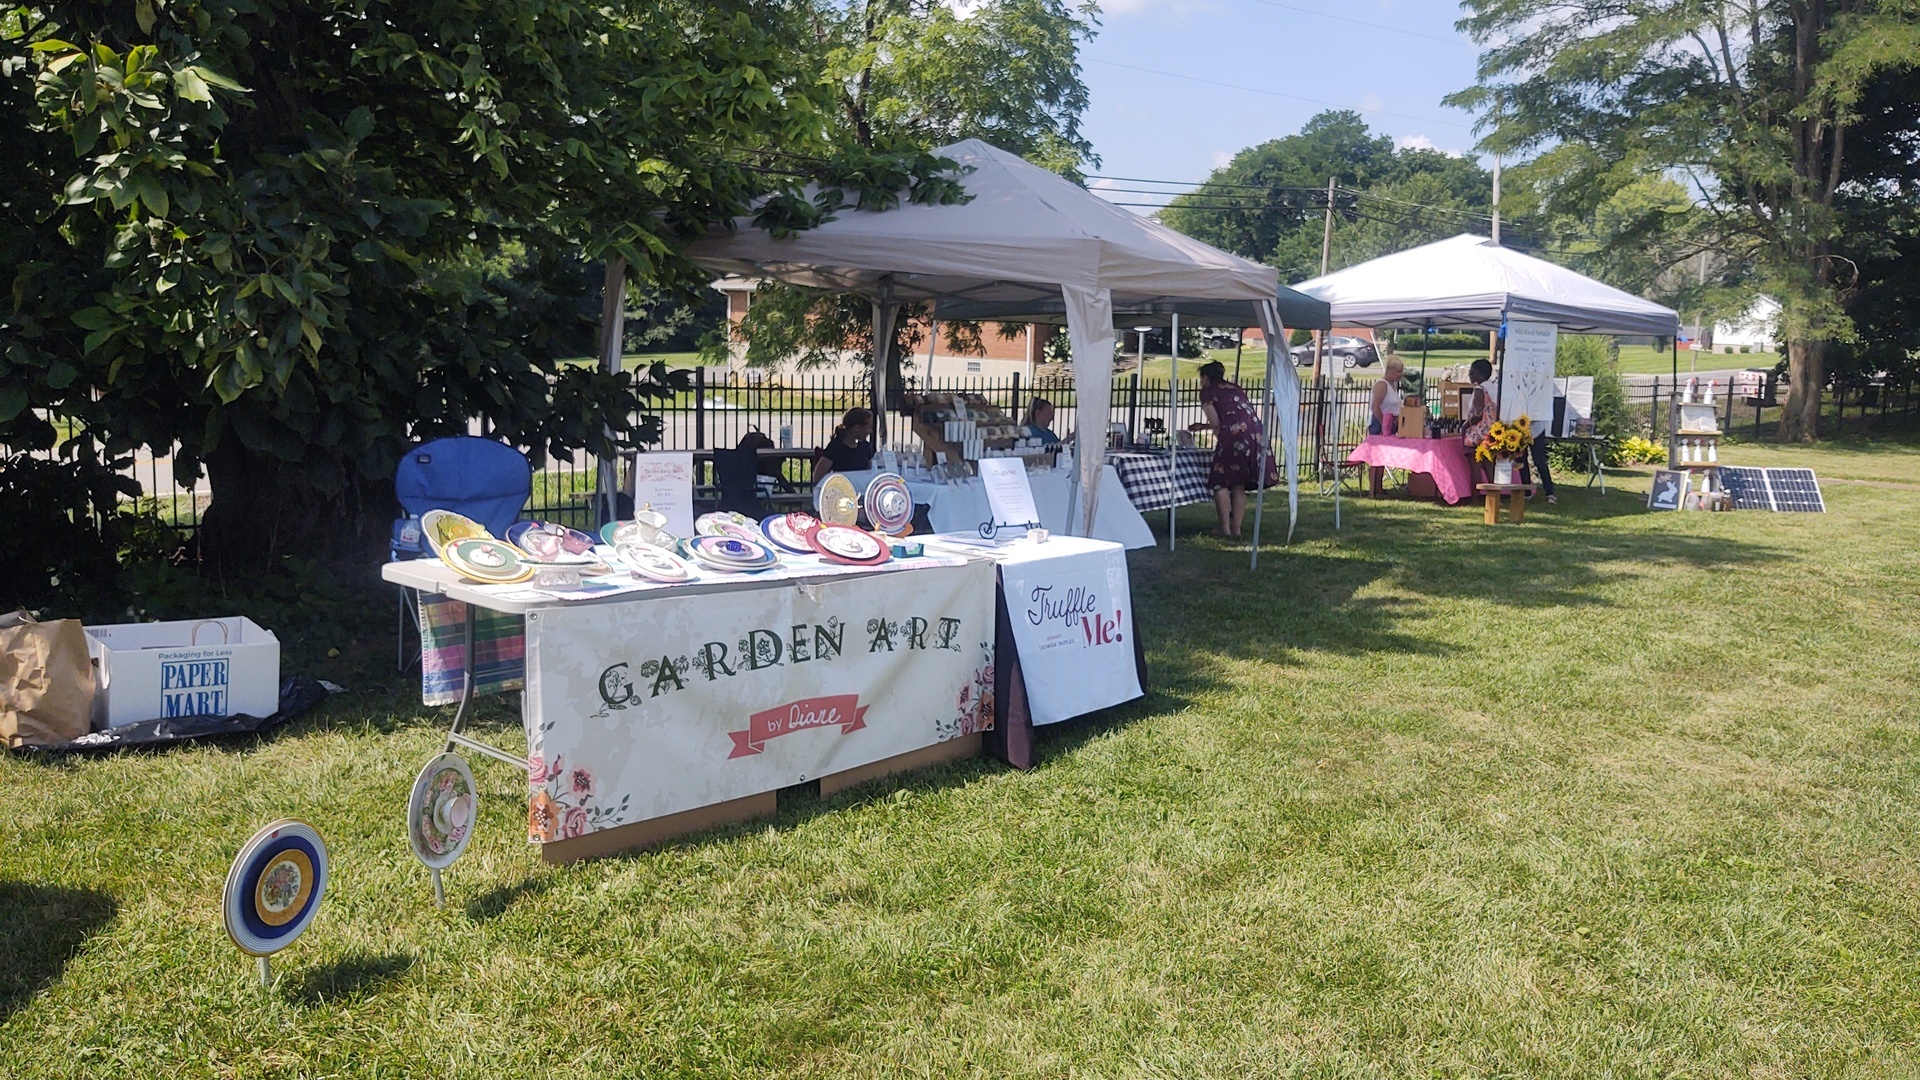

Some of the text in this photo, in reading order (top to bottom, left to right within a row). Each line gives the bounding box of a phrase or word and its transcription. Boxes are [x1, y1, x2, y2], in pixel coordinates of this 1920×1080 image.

[1027, 584, 1097, 628] Truffle
[1080, 609, 1123, 649] Me!
[158, 651, 201, 660] Packaging
[595, 615, 963, 714] GARDEN ART
[162, 661, 228, 690] PAPER
[164, 690, 224, 718] MART
[767, 703, 843, 733] by Diane
